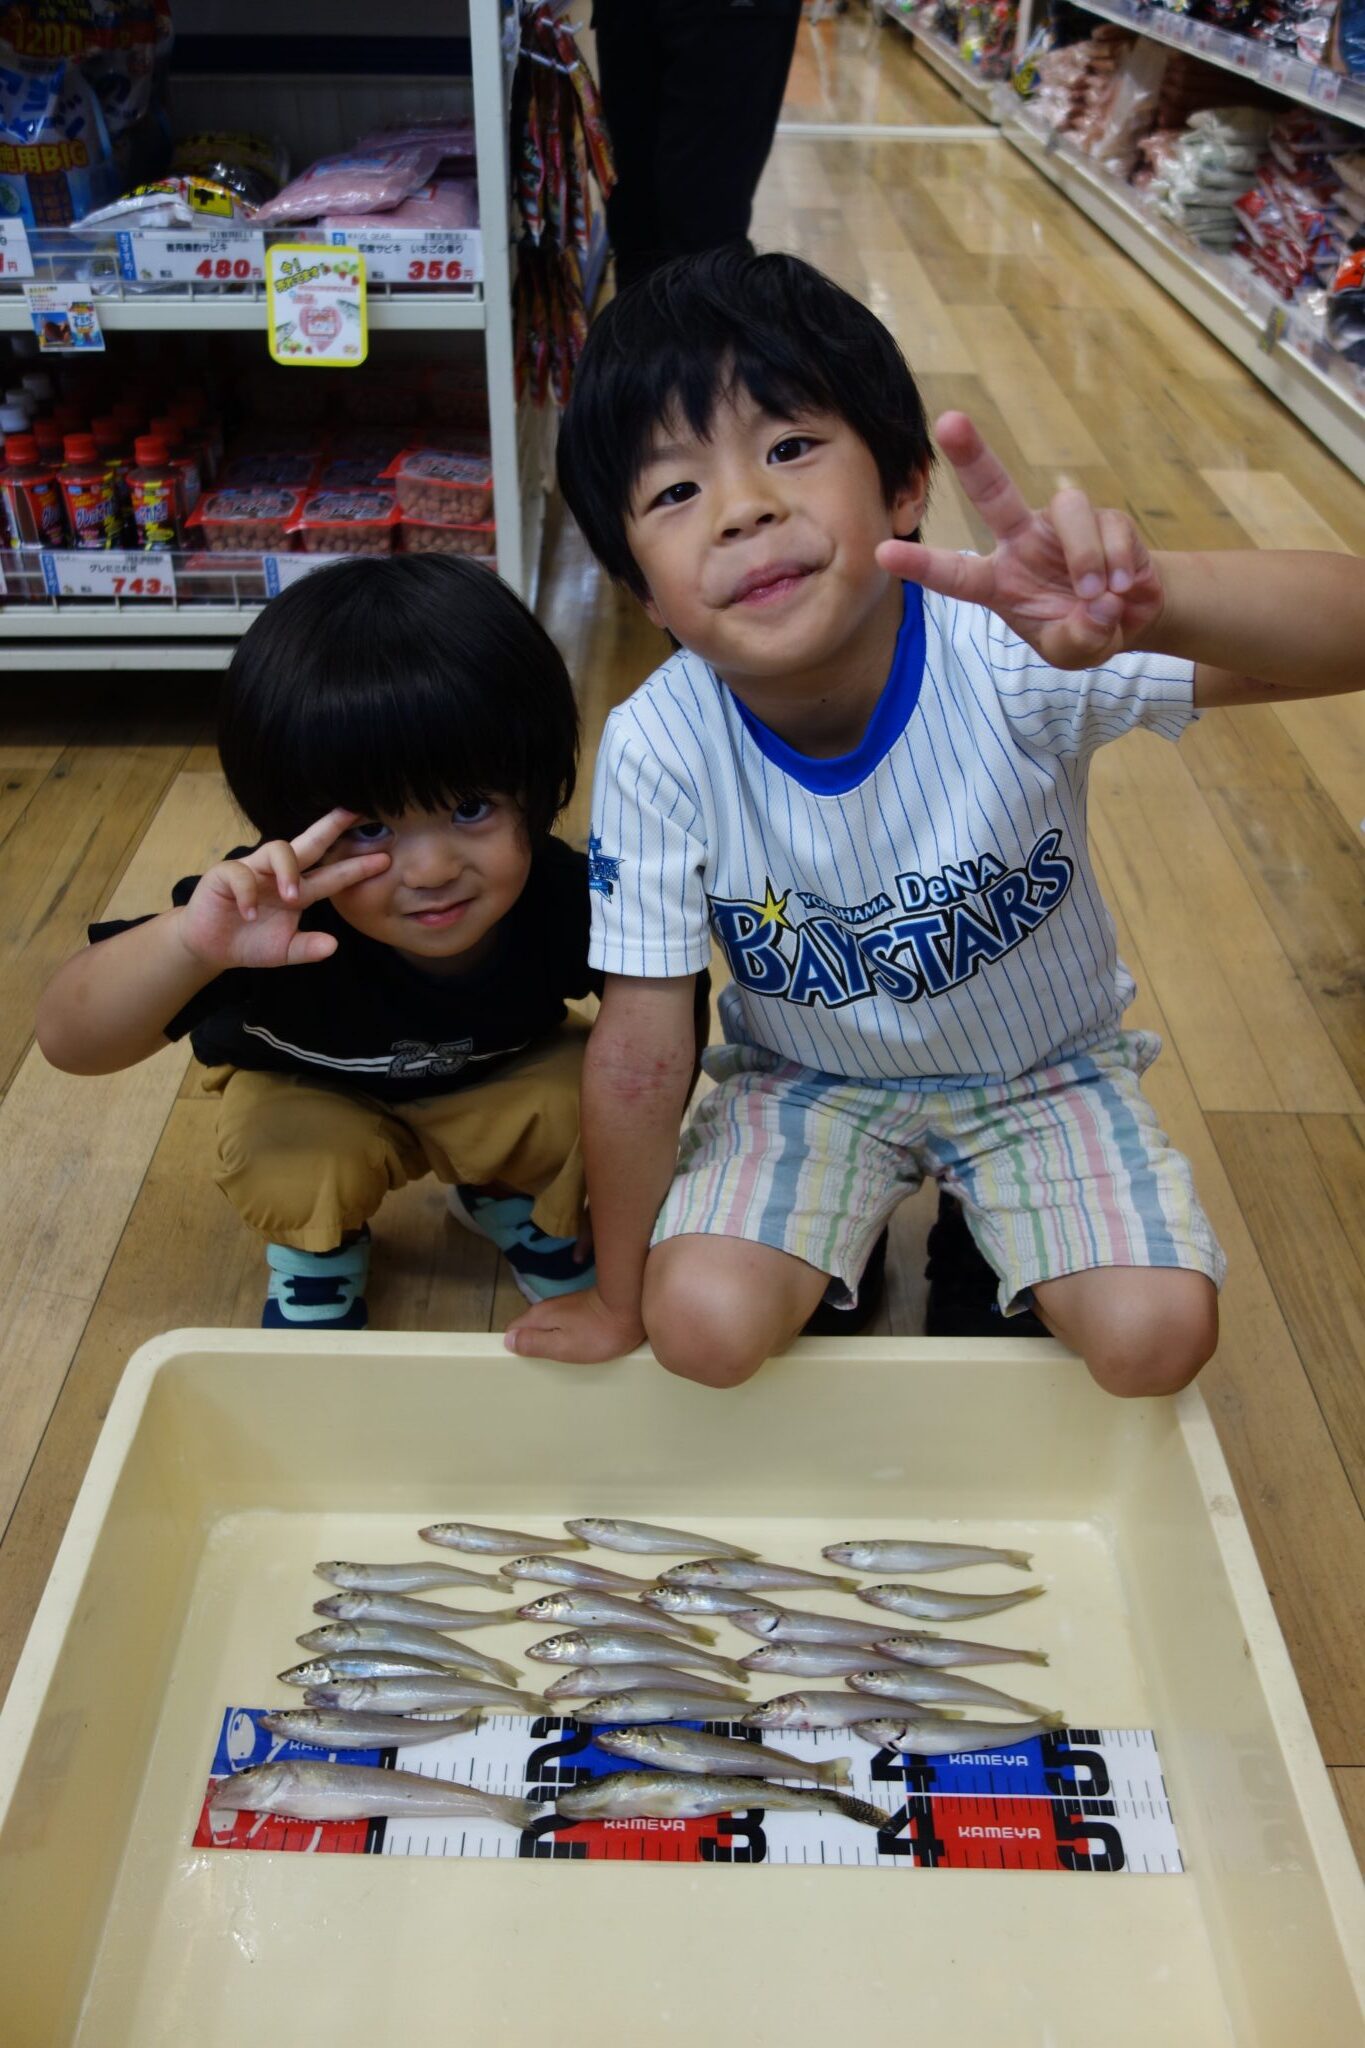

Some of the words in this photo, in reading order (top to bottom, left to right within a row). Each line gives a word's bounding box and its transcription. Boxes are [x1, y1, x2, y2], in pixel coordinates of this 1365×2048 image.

[704, 829, 1073, 1008] BAYSTARS
[798, 893, 894, 923] YOKOHAMA
[897, 854, 1008, 911] DeNA
[387, 1037, 473, 1080] 25
[525, 1716, 592, 1782] 2
[948, 1753, 1029, 1767] KAMEYA
[1041, 1730, 1110, 1796] 5
[603, 1818, 687, 1832] KAMEYA
[957, 1825, 1042, 1840] KAMEYA
[1050, 1799, 1126, 1872] 5
